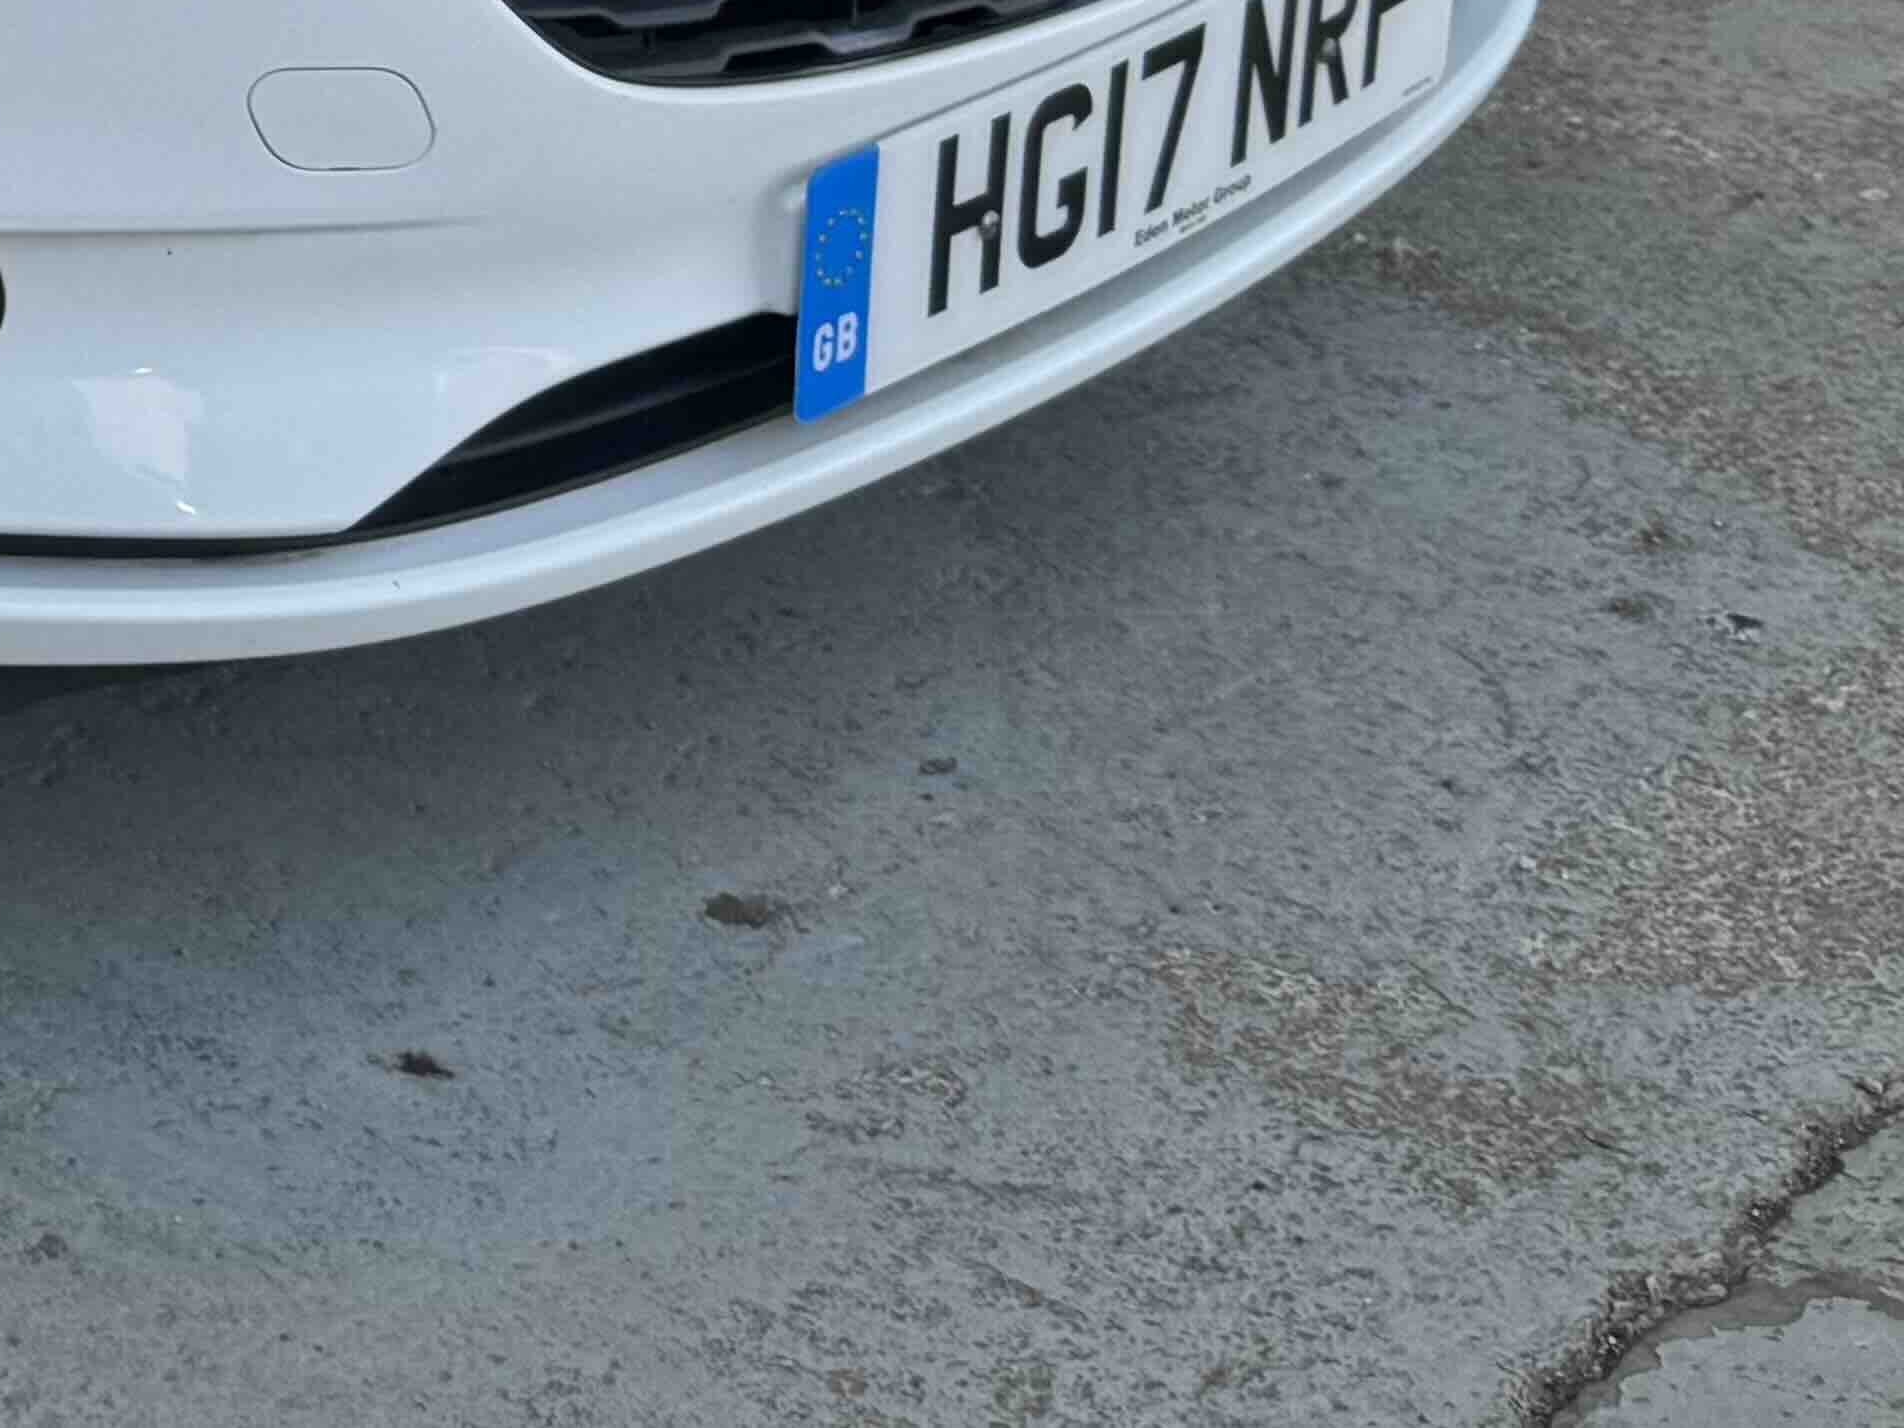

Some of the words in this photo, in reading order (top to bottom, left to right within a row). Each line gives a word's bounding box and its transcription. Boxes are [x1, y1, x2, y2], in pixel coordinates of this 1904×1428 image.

[927, 21, 1207, 318] HG17
[1133, 219, 1169, 247] Eden
[1171, 194, 1210, 227] Motor
[1213, 173, 1252, 204] Group
[812, 311, 860, 373] GB
